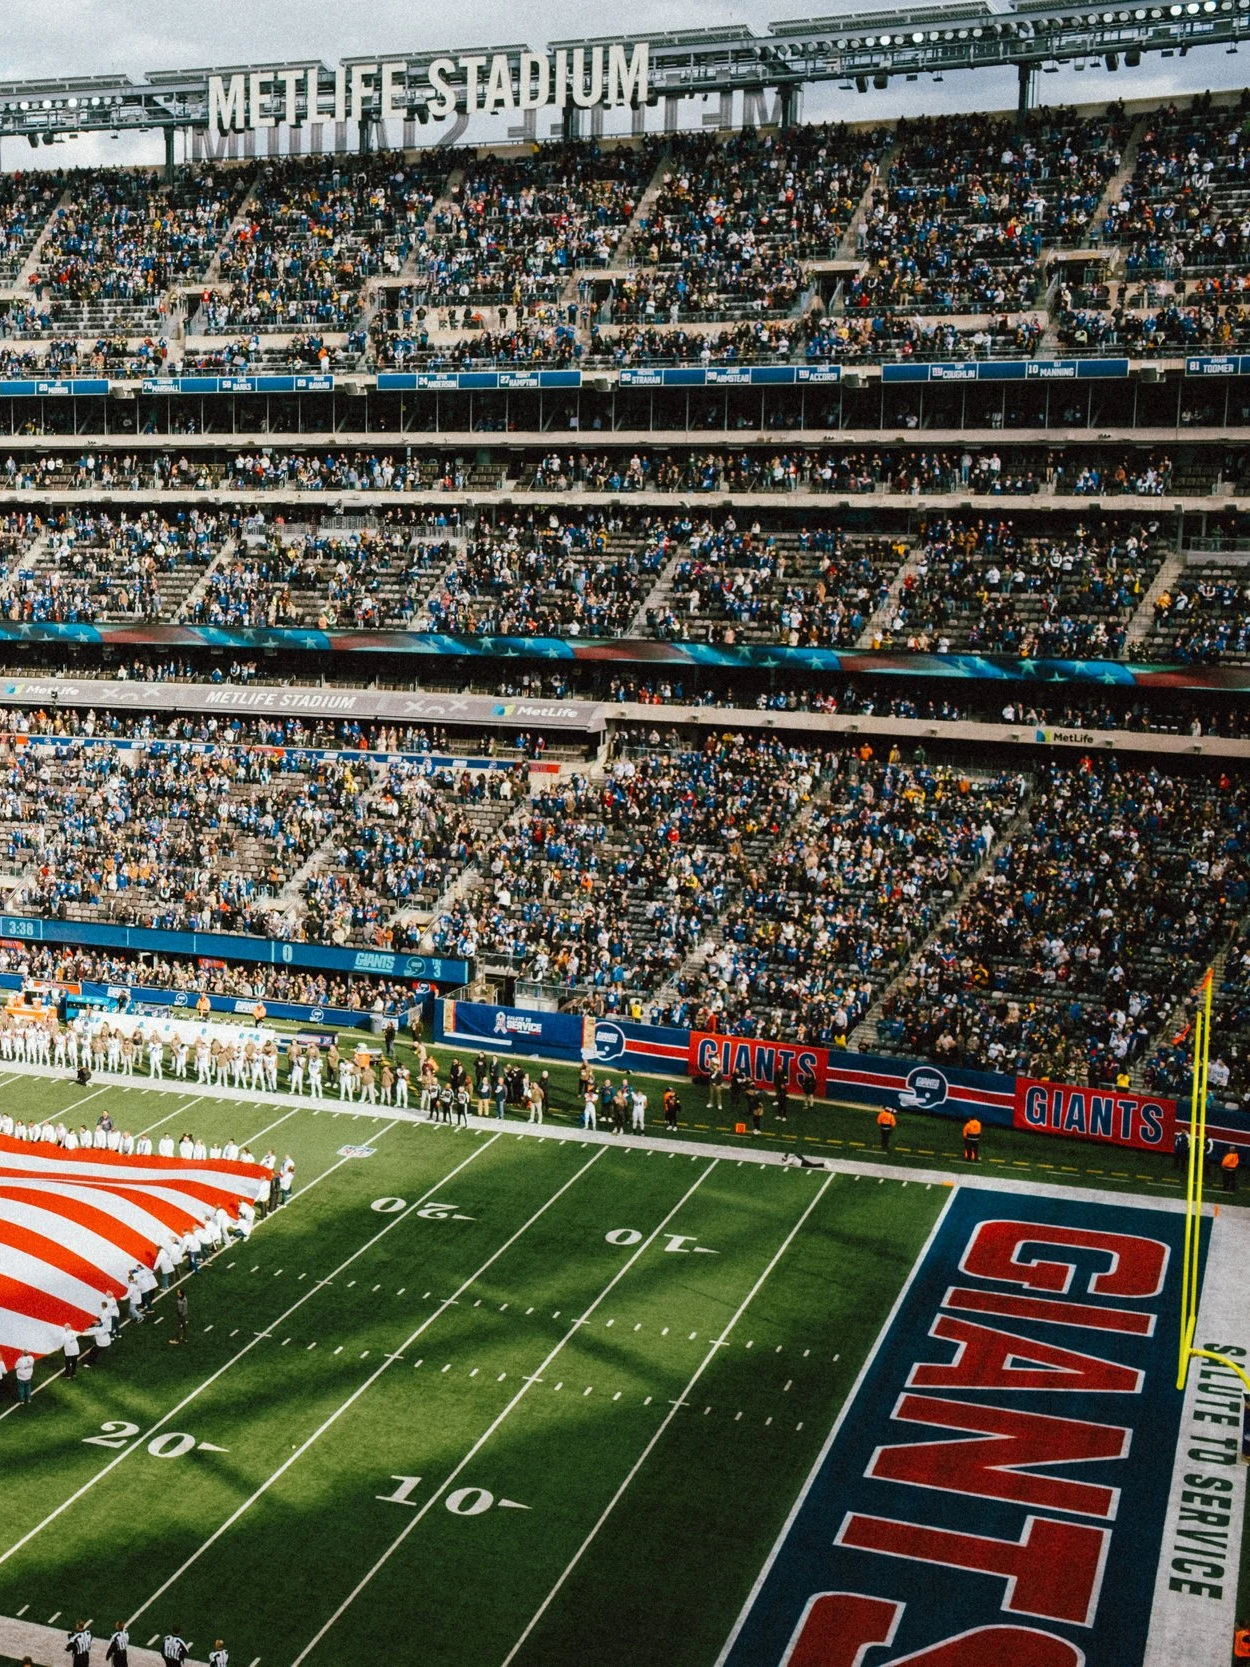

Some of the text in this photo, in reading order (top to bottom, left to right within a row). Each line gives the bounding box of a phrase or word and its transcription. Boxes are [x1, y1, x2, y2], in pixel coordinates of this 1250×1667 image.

[209, 62, 407, 131] METLIFE
[427, 42, 649, 117] STADIUM
[943, 370, 976, 379] COUGHLIN
[1028, 364, 1039, 374] 10
[1040, 368, 1075, 377] MANNING
[419, 377, 428, 385] 24
[501, 376, 510, 384] 27
[631, 376, 661, 384] STRAHAN
[809, 373, 837, 381] ACCORSI
[25, 684, 80, 697] MetLife
[206, 691, 357, 710] METLIFE STADIUM
[517, 706, 578, 718] MetLife
[1053, 733, 1094, 744] MetLife
[9, 921, 34, 936] 3:38
[282, 944, 293, 963] 0
[355, 952, 395, 969] GIANTS
[433, 966, 441, 978] 3
[506, 1021, 542, 1032] SERVICE
[698, 1039, 818, 1086] GIANTS
[1024, 1085, 1165, 1145] GIANTS
[370, 1196, 460, 1219] 20
[605, 1229, 698, 1253] 10
[82, 1420, 196, 1459] 20
[1187, 1435, 1239, 1466] TO
[375, 1475, 496, 1516] 10
[1169, 1473, 1234, 1600] SERVICE
